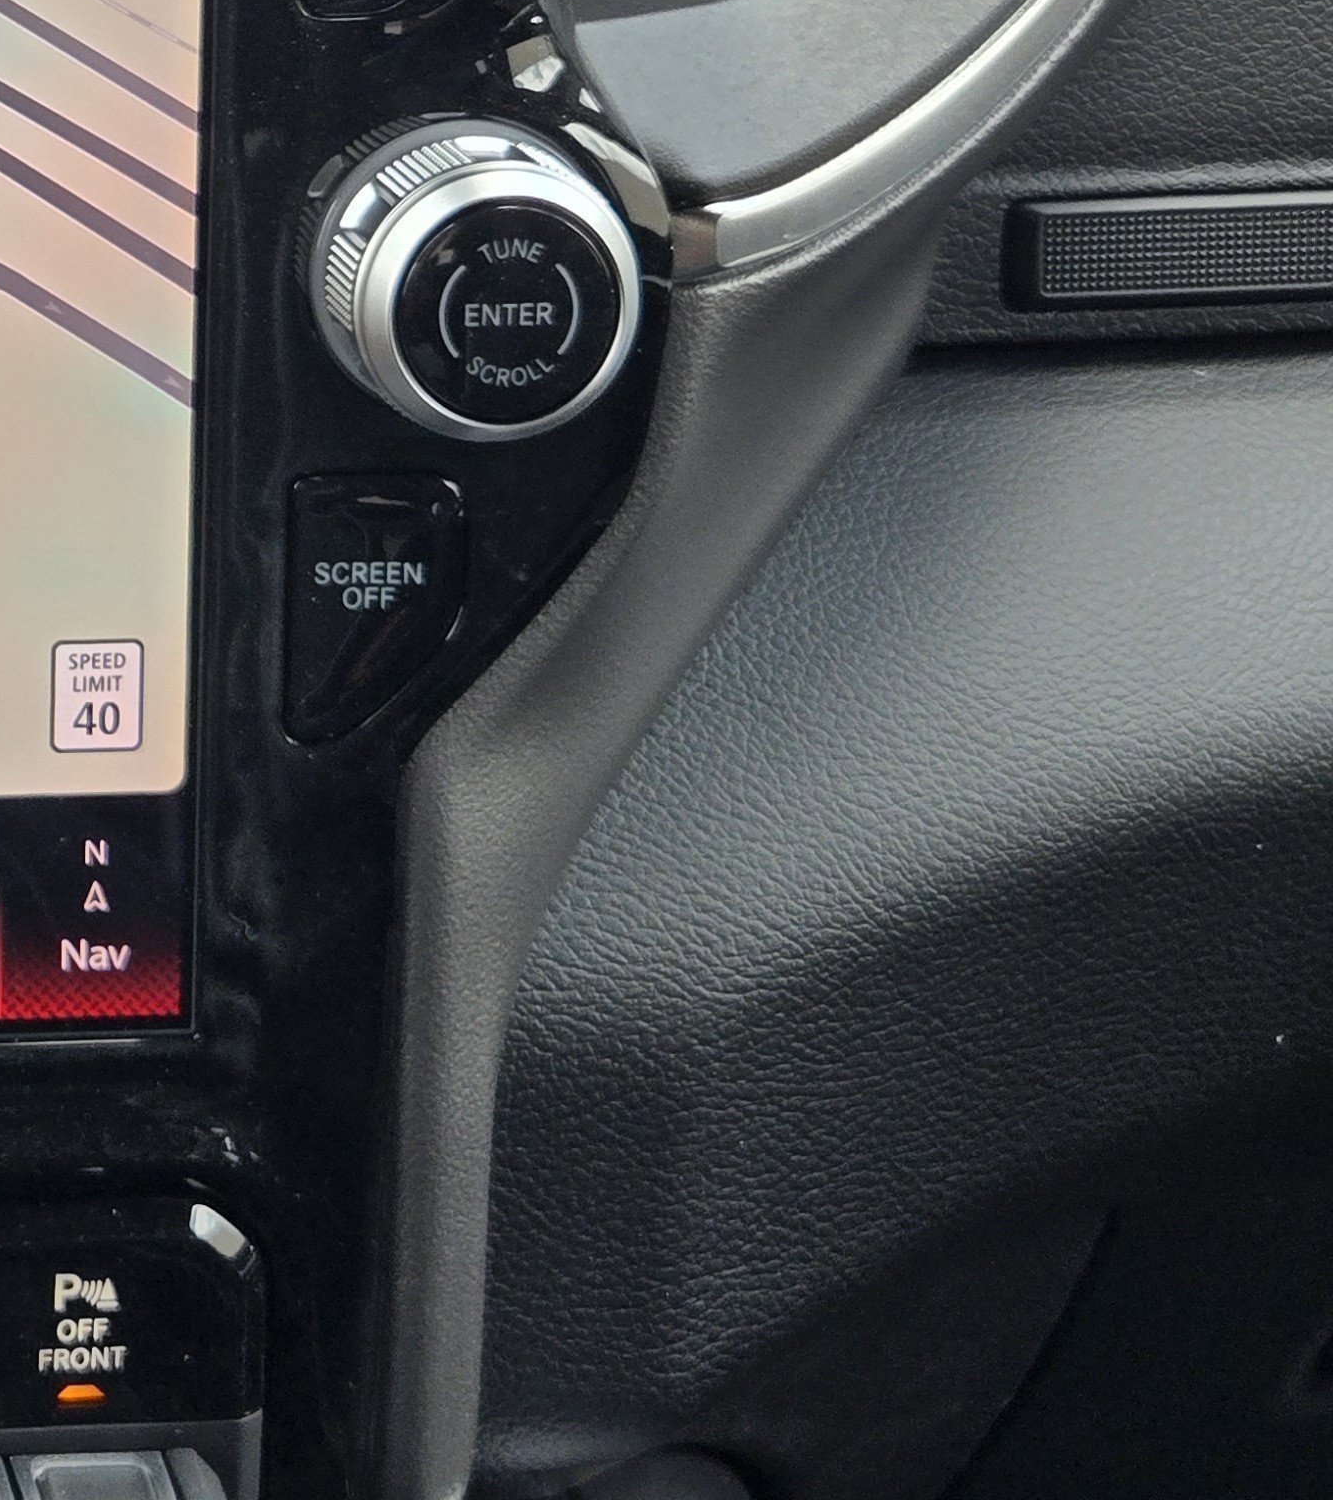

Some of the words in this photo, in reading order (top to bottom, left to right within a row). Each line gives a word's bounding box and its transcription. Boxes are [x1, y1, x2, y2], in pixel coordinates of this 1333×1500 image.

[477, 237, 547, 263] TUNE
[463, 302, 554, 328] ENTER
[465, 355, 556, 388] SCROLL
[313, 561, 423, 587] SCREEN
[342, 586, 396, 611] OFF
[68, 652, 126, 670] SPEED
[72, 675, 122, 693] LIMIT
[72, 701, 121, 736] 40
[85, 840, 109, 866] N
[60, 939, 130, 971] Nav
[56, 1317, 111, 1346] OFF
[38, 1345, 127, 1373] FRONT
